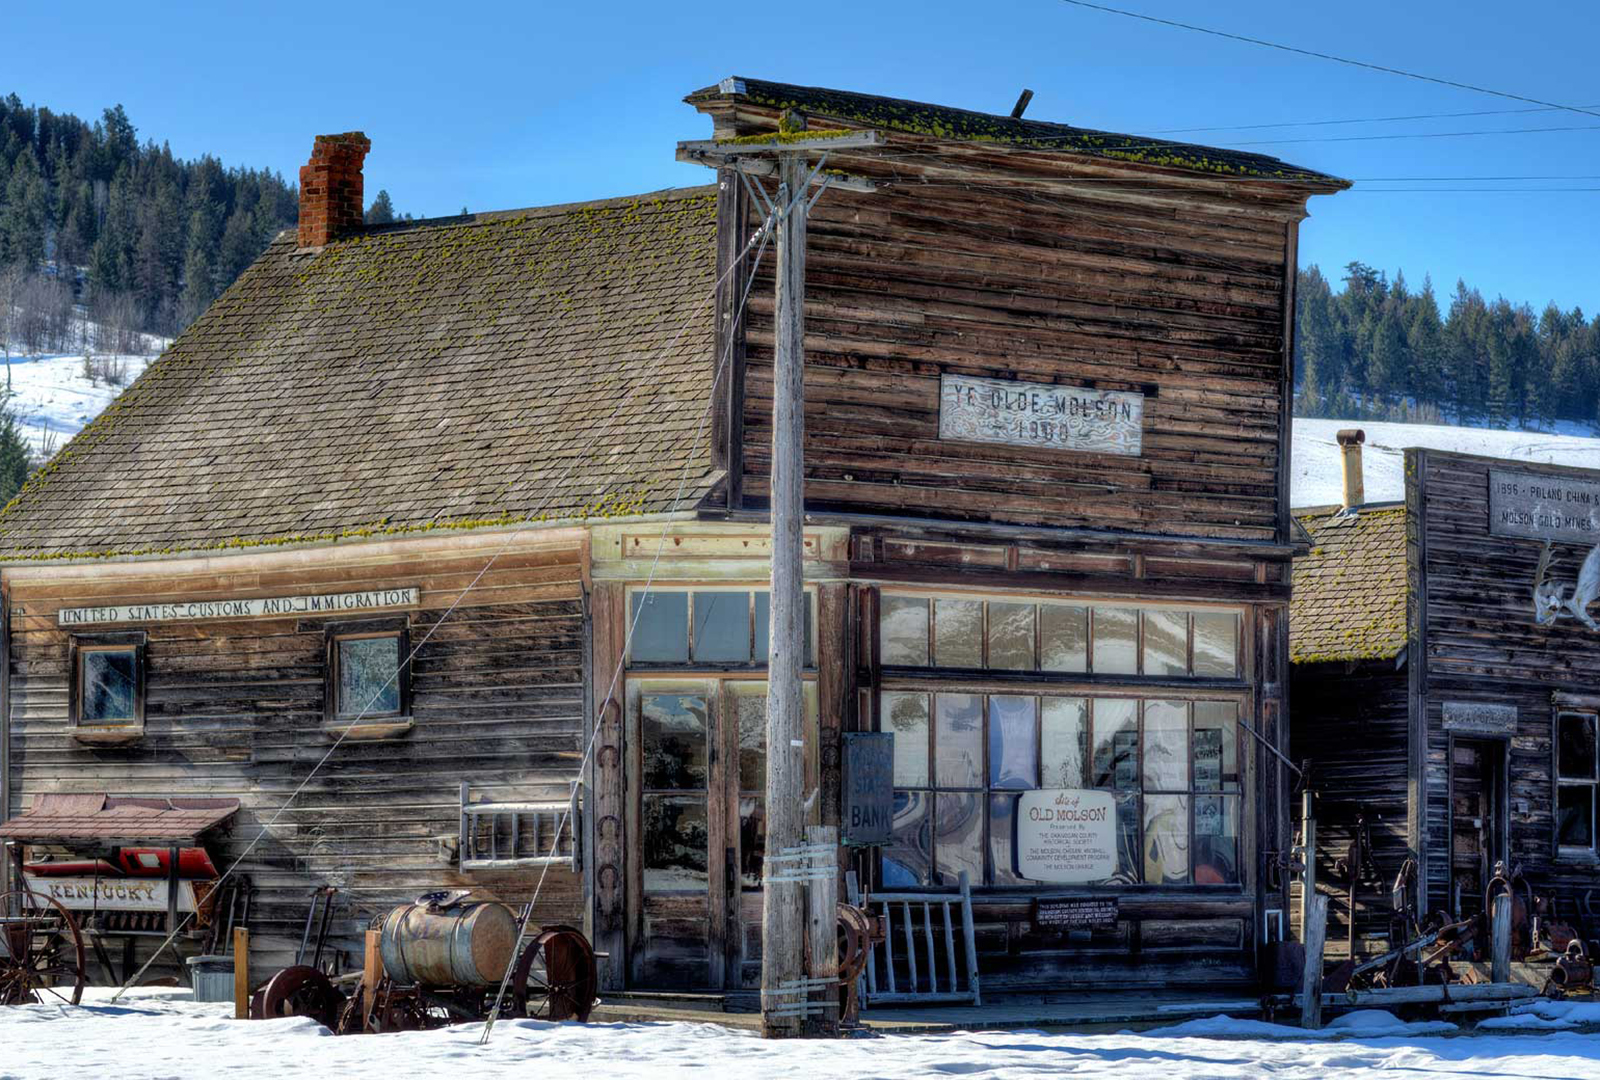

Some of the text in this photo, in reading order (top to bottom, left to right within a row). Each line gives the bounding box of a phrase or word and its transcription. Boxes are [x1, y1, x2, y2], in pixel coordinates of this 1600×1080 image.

[990, 389, 1040, 413] OLDE
[1054, 396, 1132, 421] MOLSON
[1497, 483, 1518, 495] 1896
[1530, 486, 1562, 500] POLAND
[1566, 490, 1591, 504] CHINA
[1501, 511, 1592, 531] MOLSON GOLD MINES
[63, 589, 412, 623] UNITED STATES CUSTOMS AND IMMIGRATION
[851, 805, 890, 829] BANK
[1029, 807, 1107, 821] OLD MOLSON
[48, 883, 155, 901] KENTUCKY
